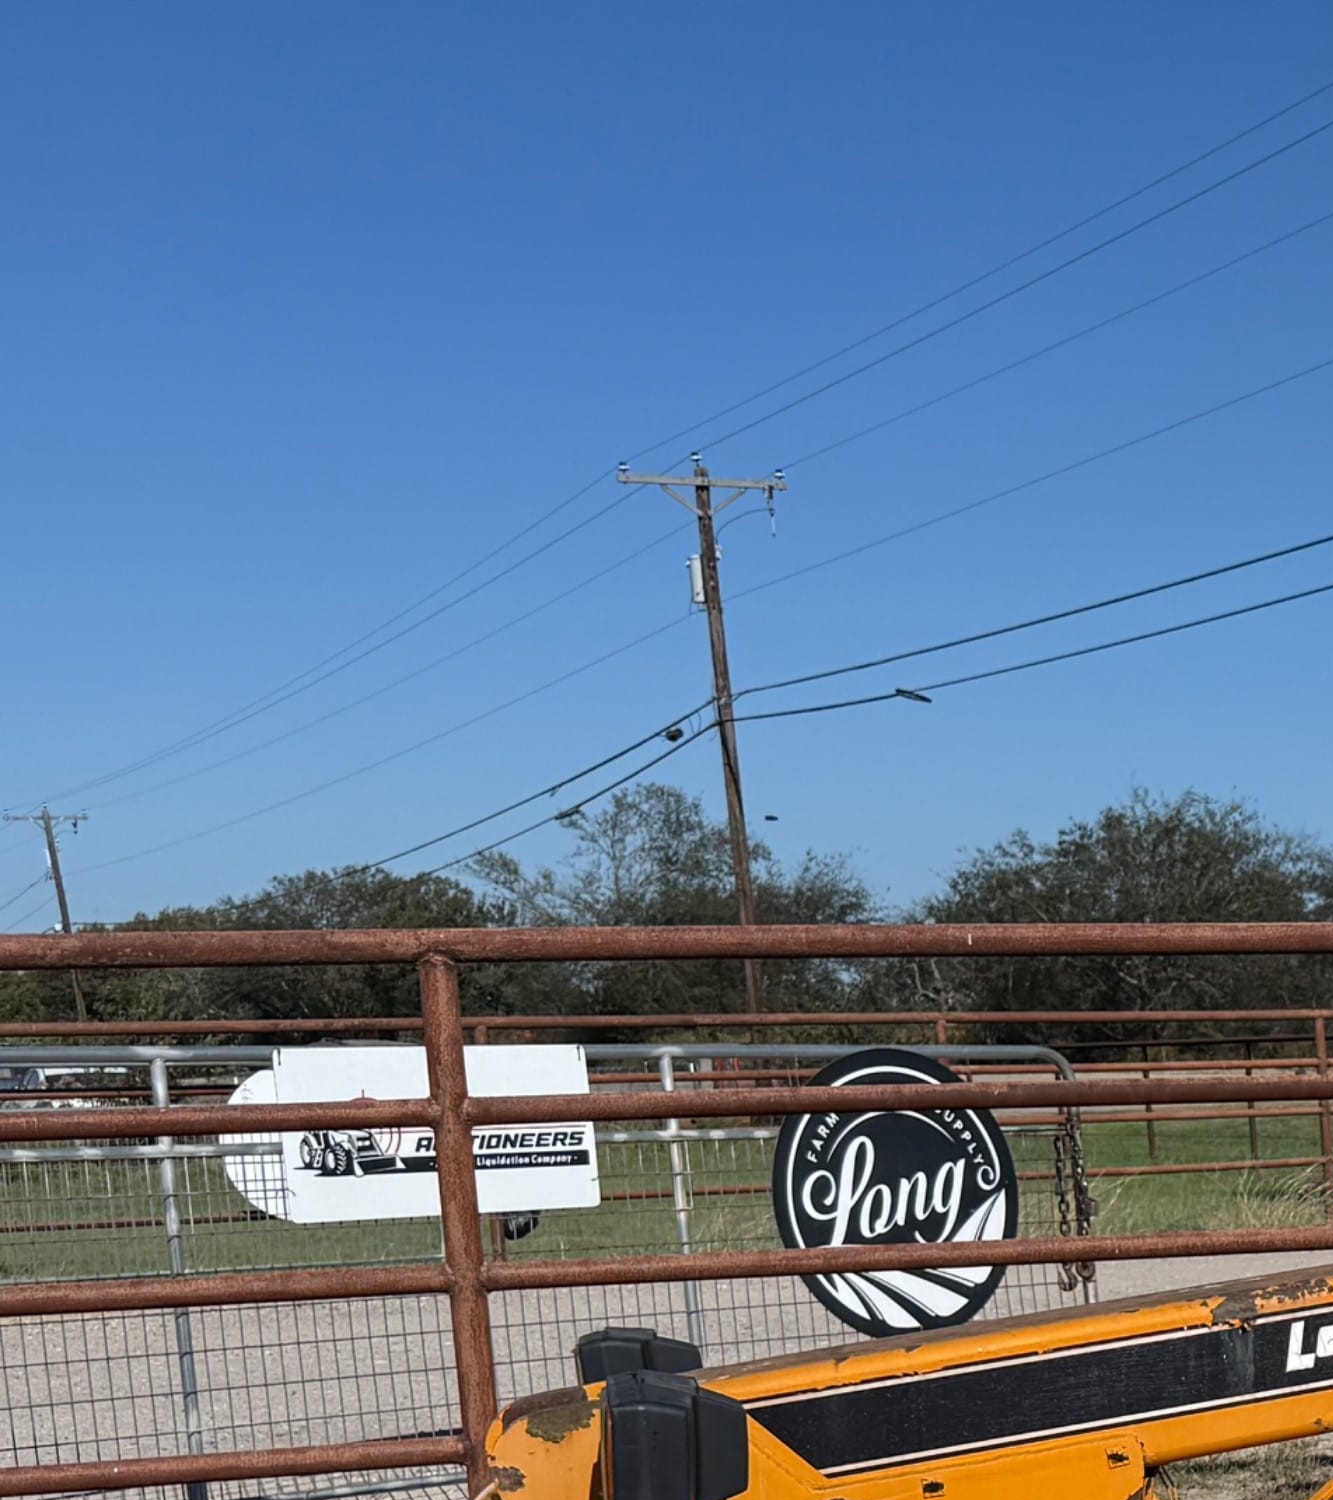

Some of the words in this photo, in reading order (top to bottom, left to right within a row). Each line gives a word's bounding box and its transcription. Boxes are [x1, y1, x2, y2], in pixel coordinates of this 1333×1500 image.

[415, 1131, 585, 1152] AIONEERS
[935, 1109, 984, 1165] UPPLY
[476, 1157, 530, 1168] Liquidation
[531, 1154, 572, 1165] Company
[802, 1135, 966, 1246] Long
